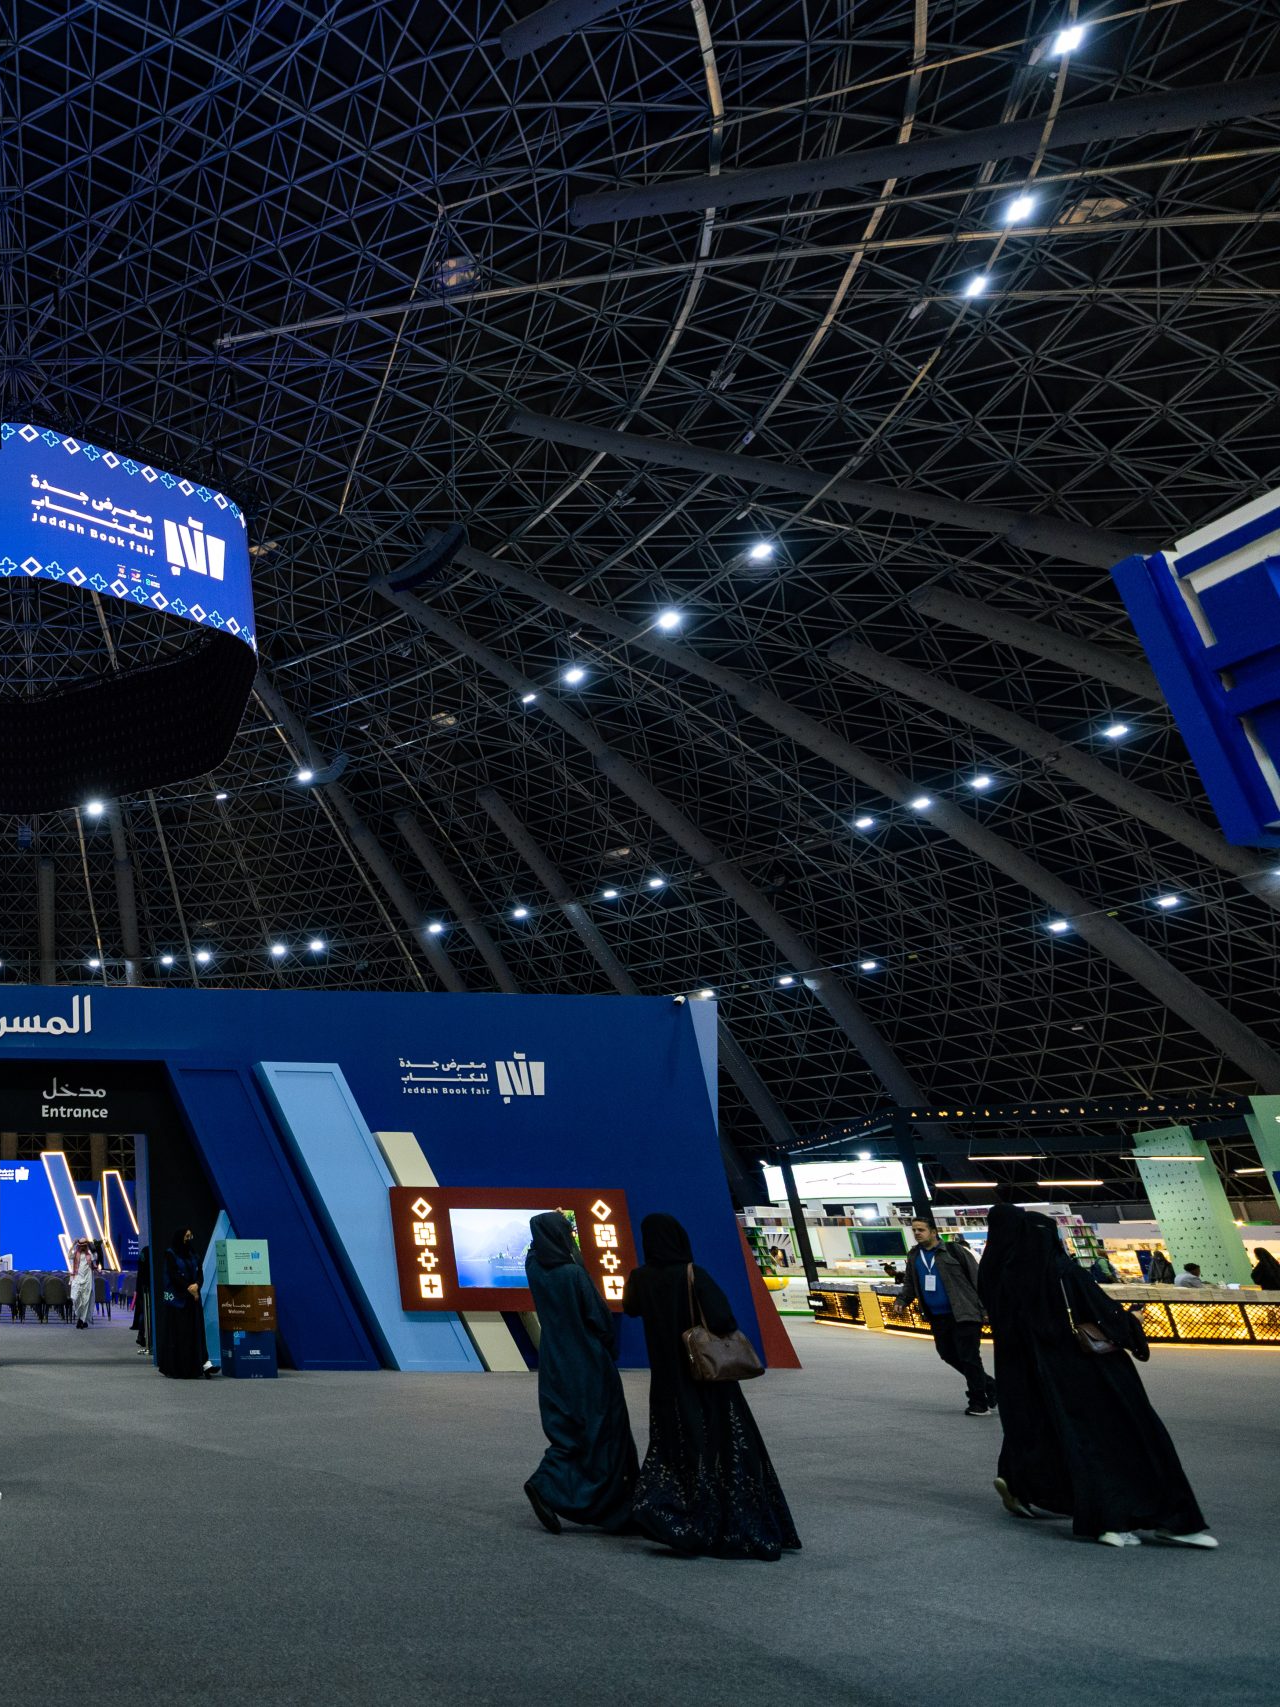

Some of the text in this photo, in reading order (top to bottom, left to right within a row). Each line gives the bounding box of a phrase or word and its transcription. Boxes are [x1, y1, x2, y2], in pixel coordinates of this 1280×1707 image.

[30, 474, 153, 524] معرض جدة
[31, 495, 154, 541] للكتاب
[31, 512, 155, 557] Jeddah Book fair
[398, 1057, 487, 1072] معرض جدة
[400, 1072, 489, 1084] للكتاب
[42, 1077, 107, 1100] مدخل
[402, 1086, 491, 1095] Jeddah Book fair
[40, 1104, 109, 1120] Entrance
